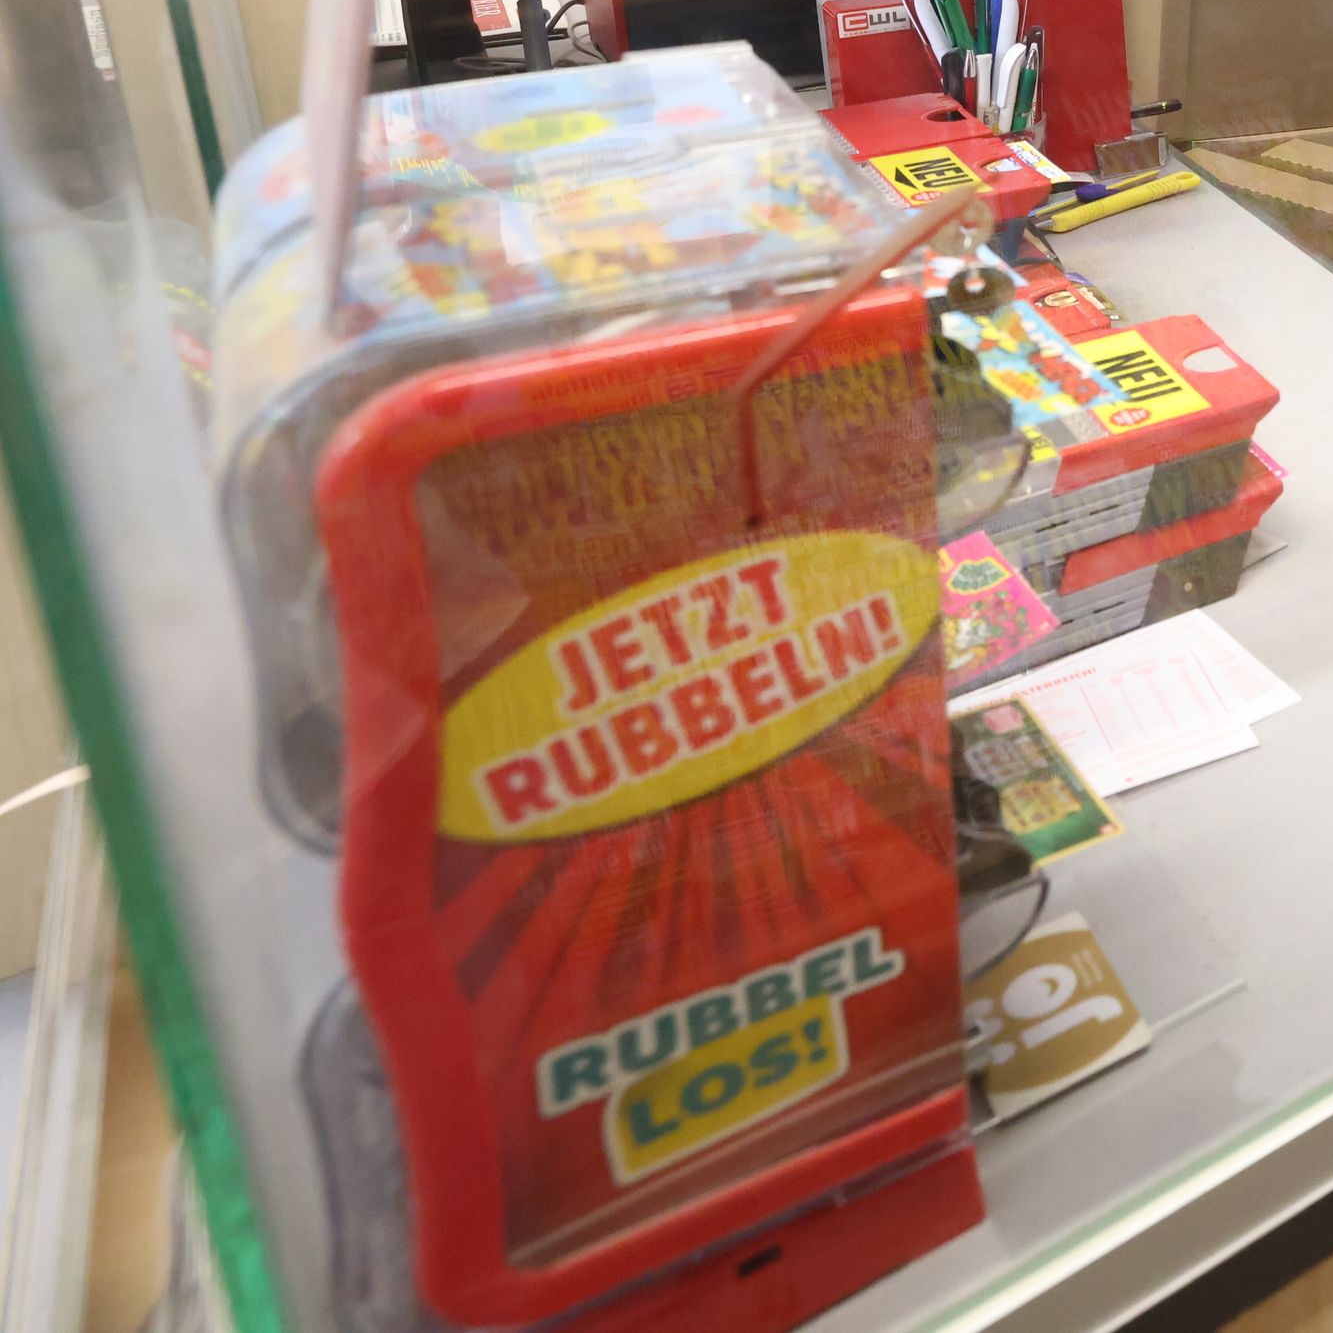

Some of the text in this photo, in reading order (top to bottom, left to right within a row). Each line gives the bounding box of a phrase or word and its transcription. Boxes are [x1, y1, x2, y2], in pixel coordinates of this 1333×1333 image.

[908, 157, 973, 190] NEU
[1103, 351, 1182, 404] NEU
[558, 558, 788, 712] JETZT
[485, 595, 900, 827] RUBBELN!
[548, 935, 901, 1105] RUBBEL
[627, 1015, 825, 1147] LOS!
